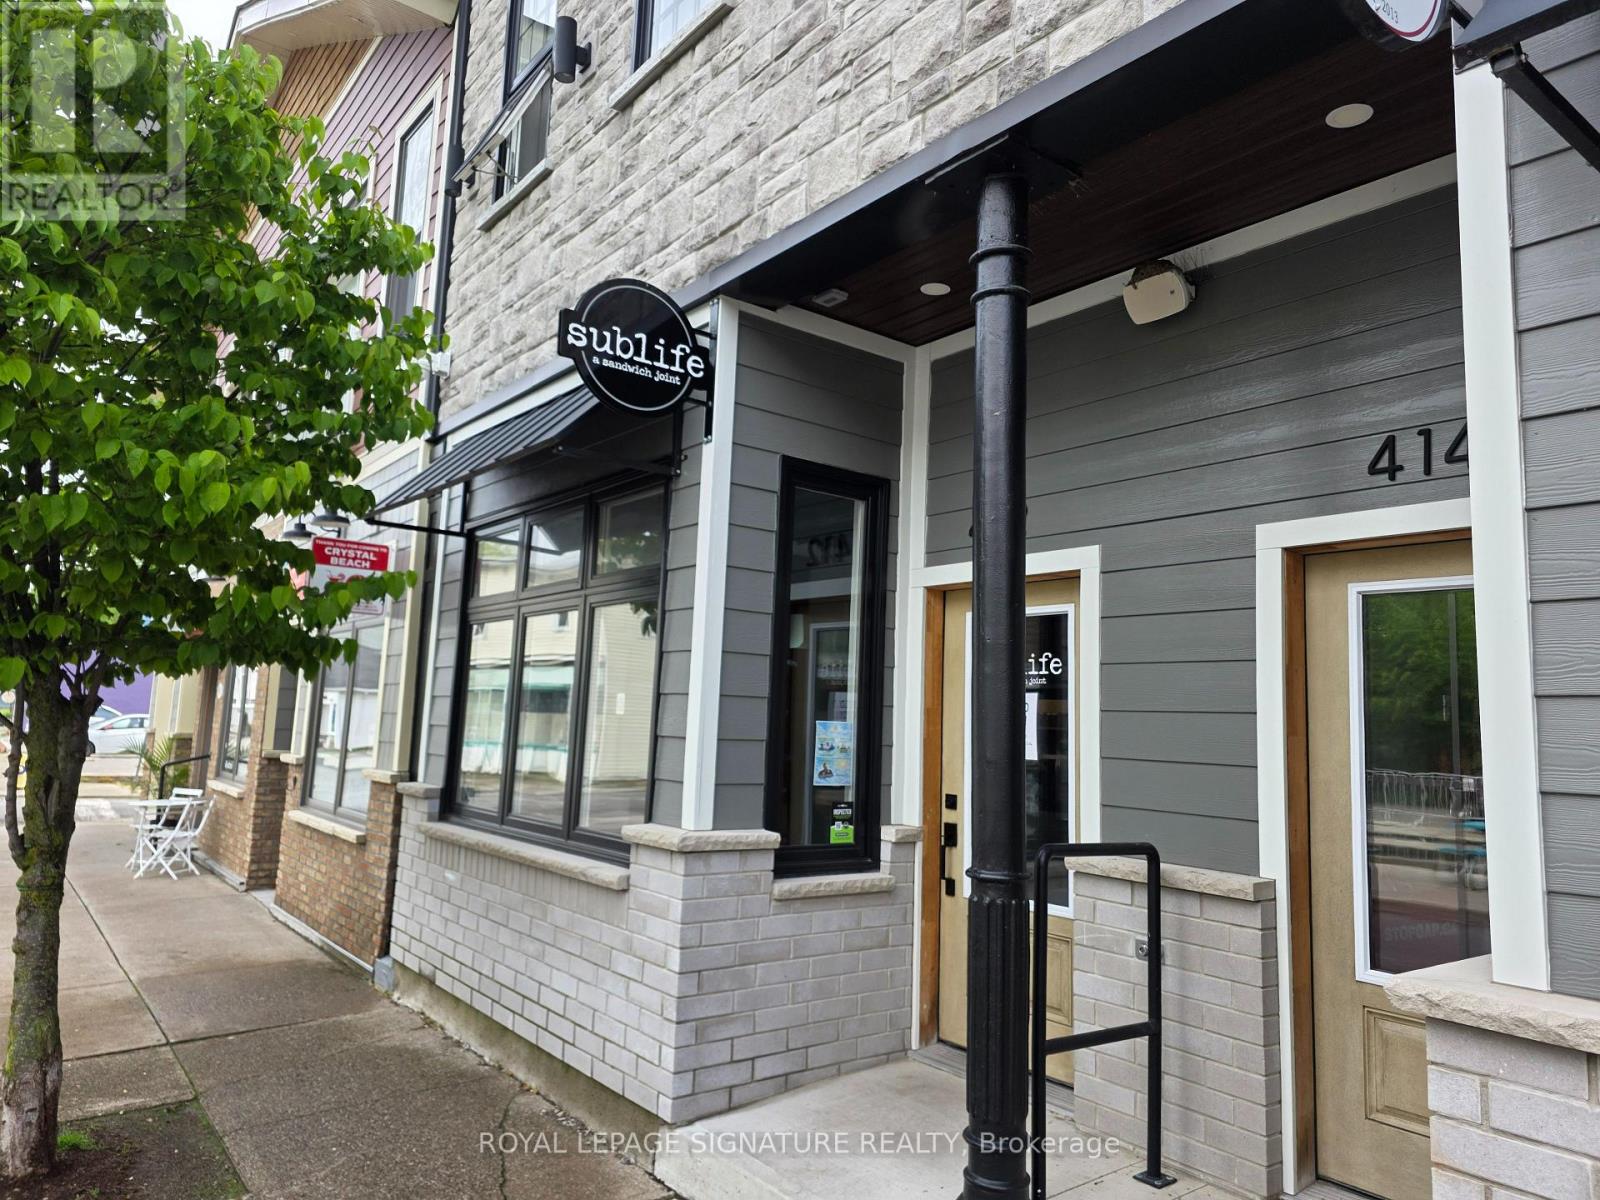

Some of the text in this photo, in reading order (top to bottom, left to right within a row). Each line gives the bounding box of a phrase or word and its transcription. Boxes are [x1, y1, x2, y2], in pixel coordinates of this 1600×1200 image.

[567, 322, 705, 378] sublife
[592, 356, 681, 385] a sandwich joint
[324, 546, 378, 561] CRYSTAL
[330, 556, 370, 569] BEACH
